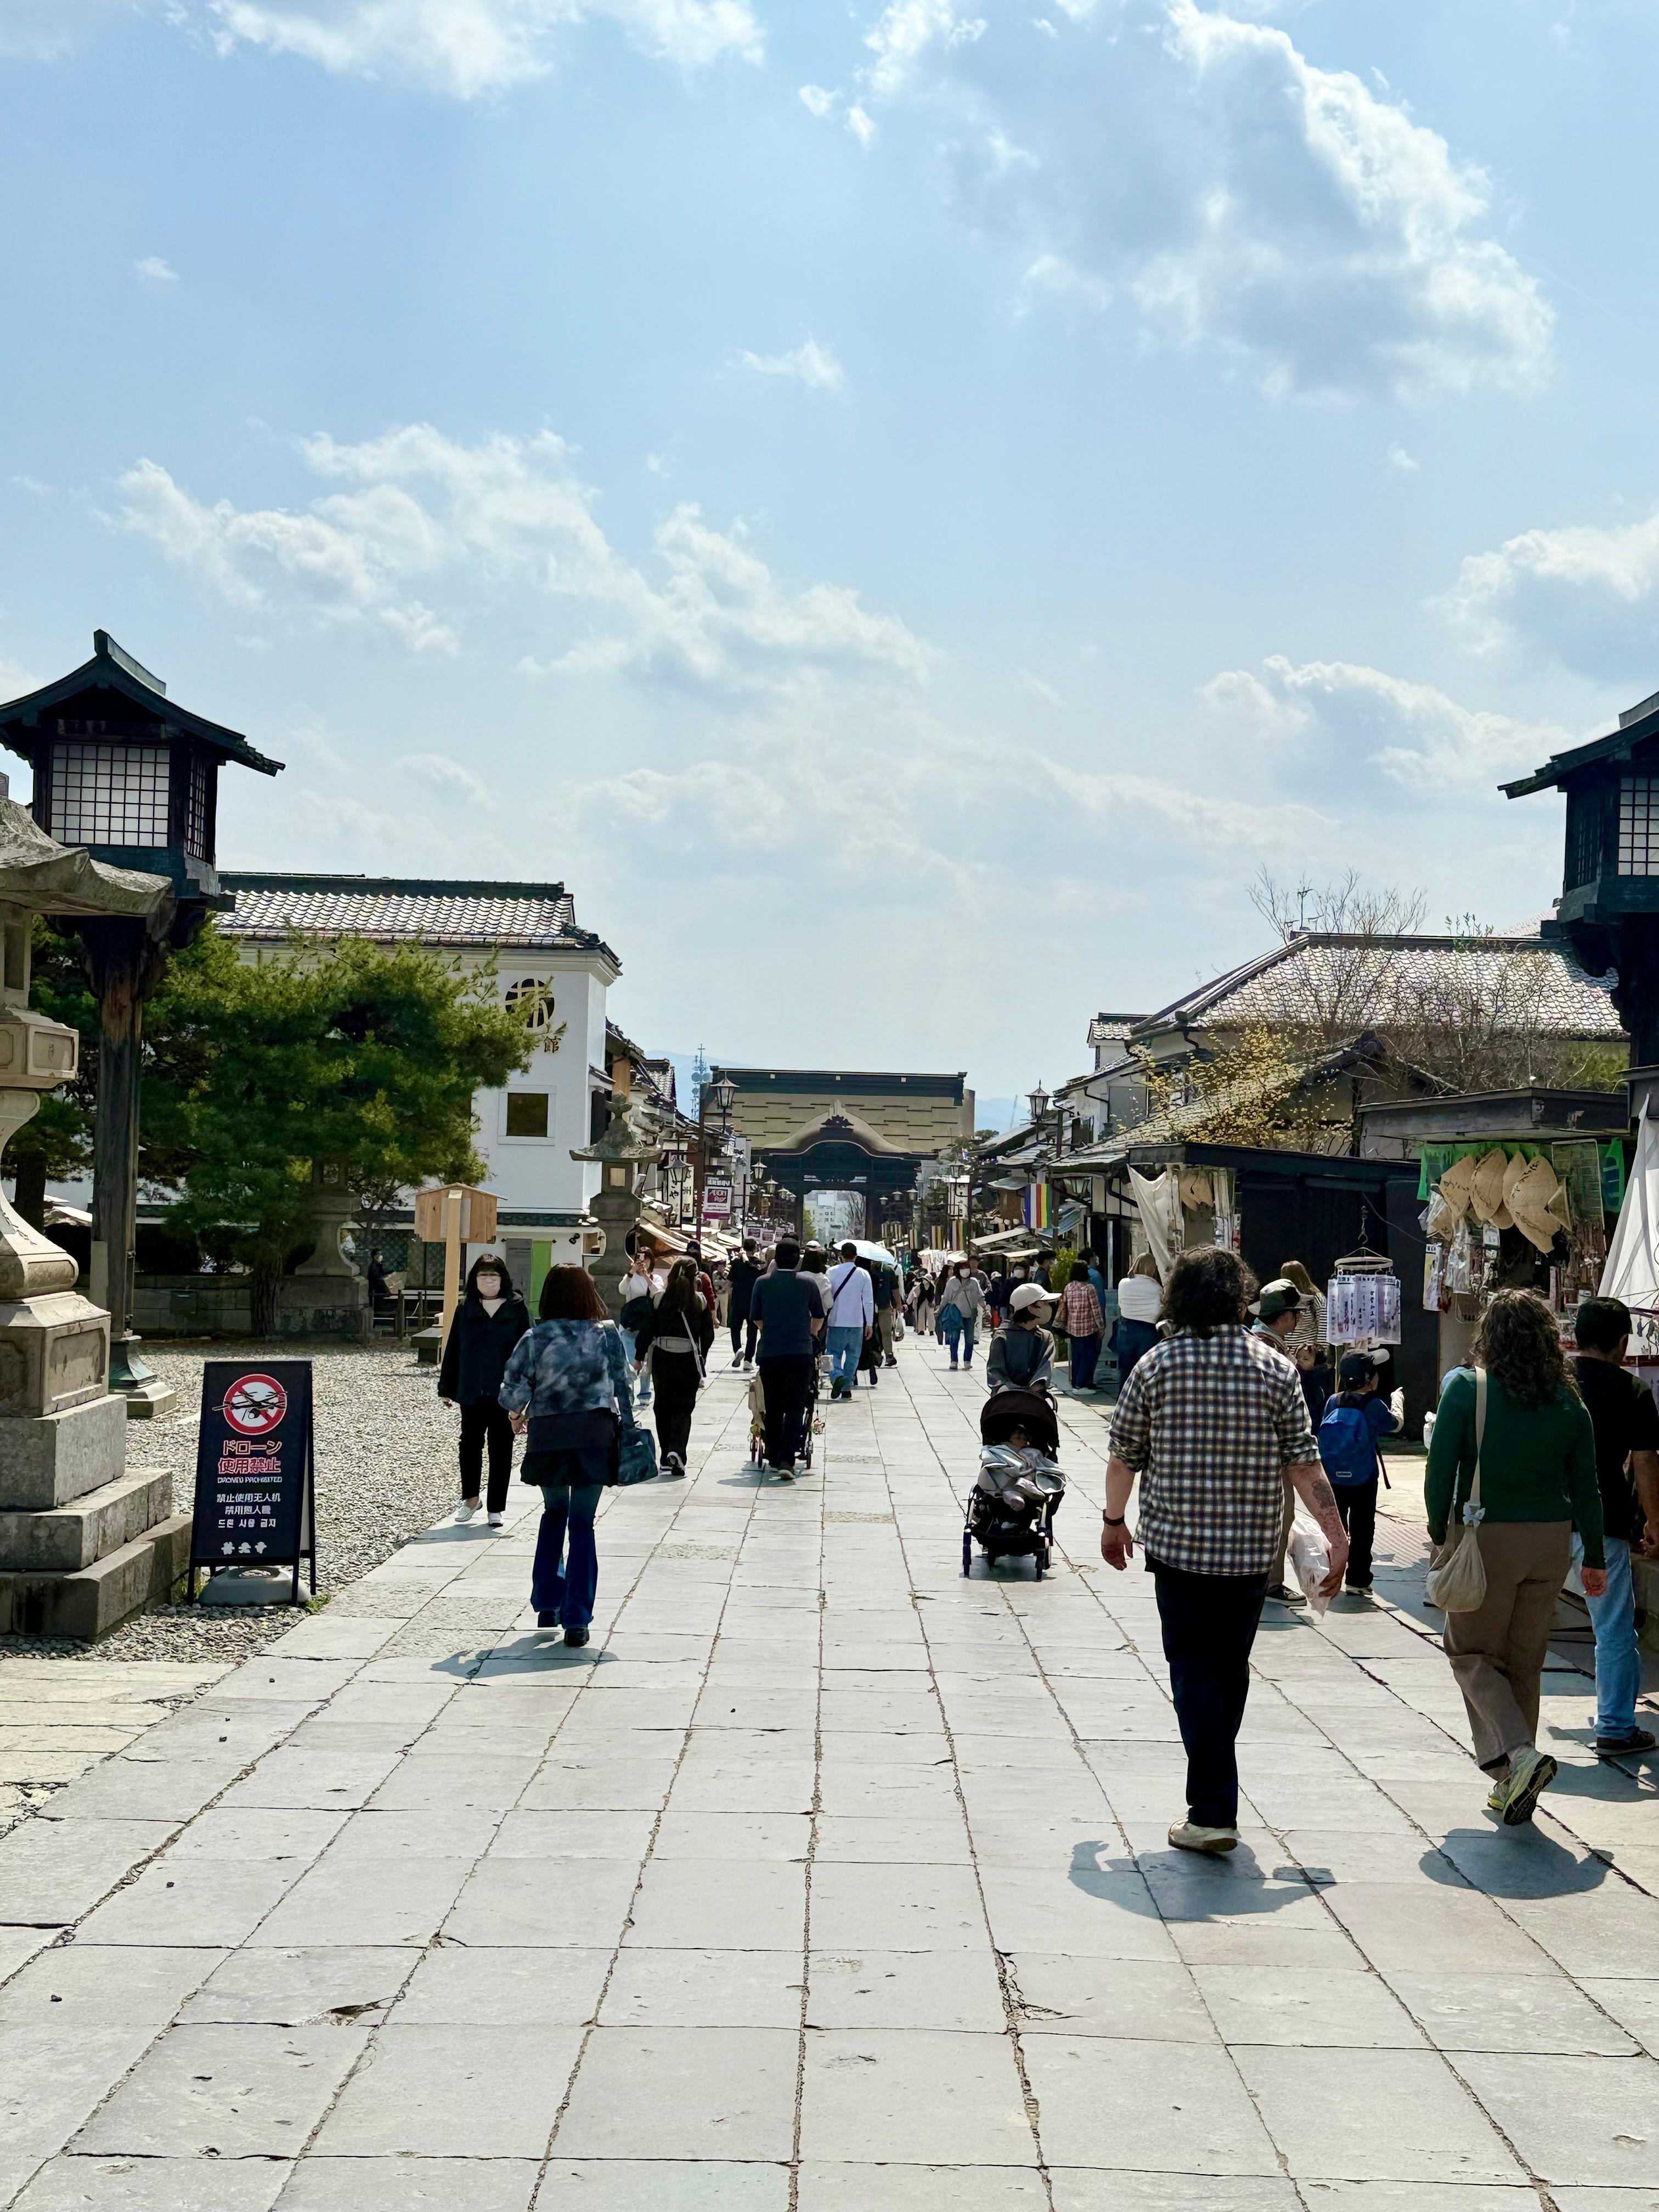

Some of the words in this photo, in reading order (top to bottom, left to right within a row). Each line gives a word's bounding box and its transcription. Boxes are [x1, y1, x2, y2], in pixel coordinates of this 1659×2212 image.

[223, 1440, 283, 1455] ドローン
[218, 1457, 281, 1474] 使用禁止
